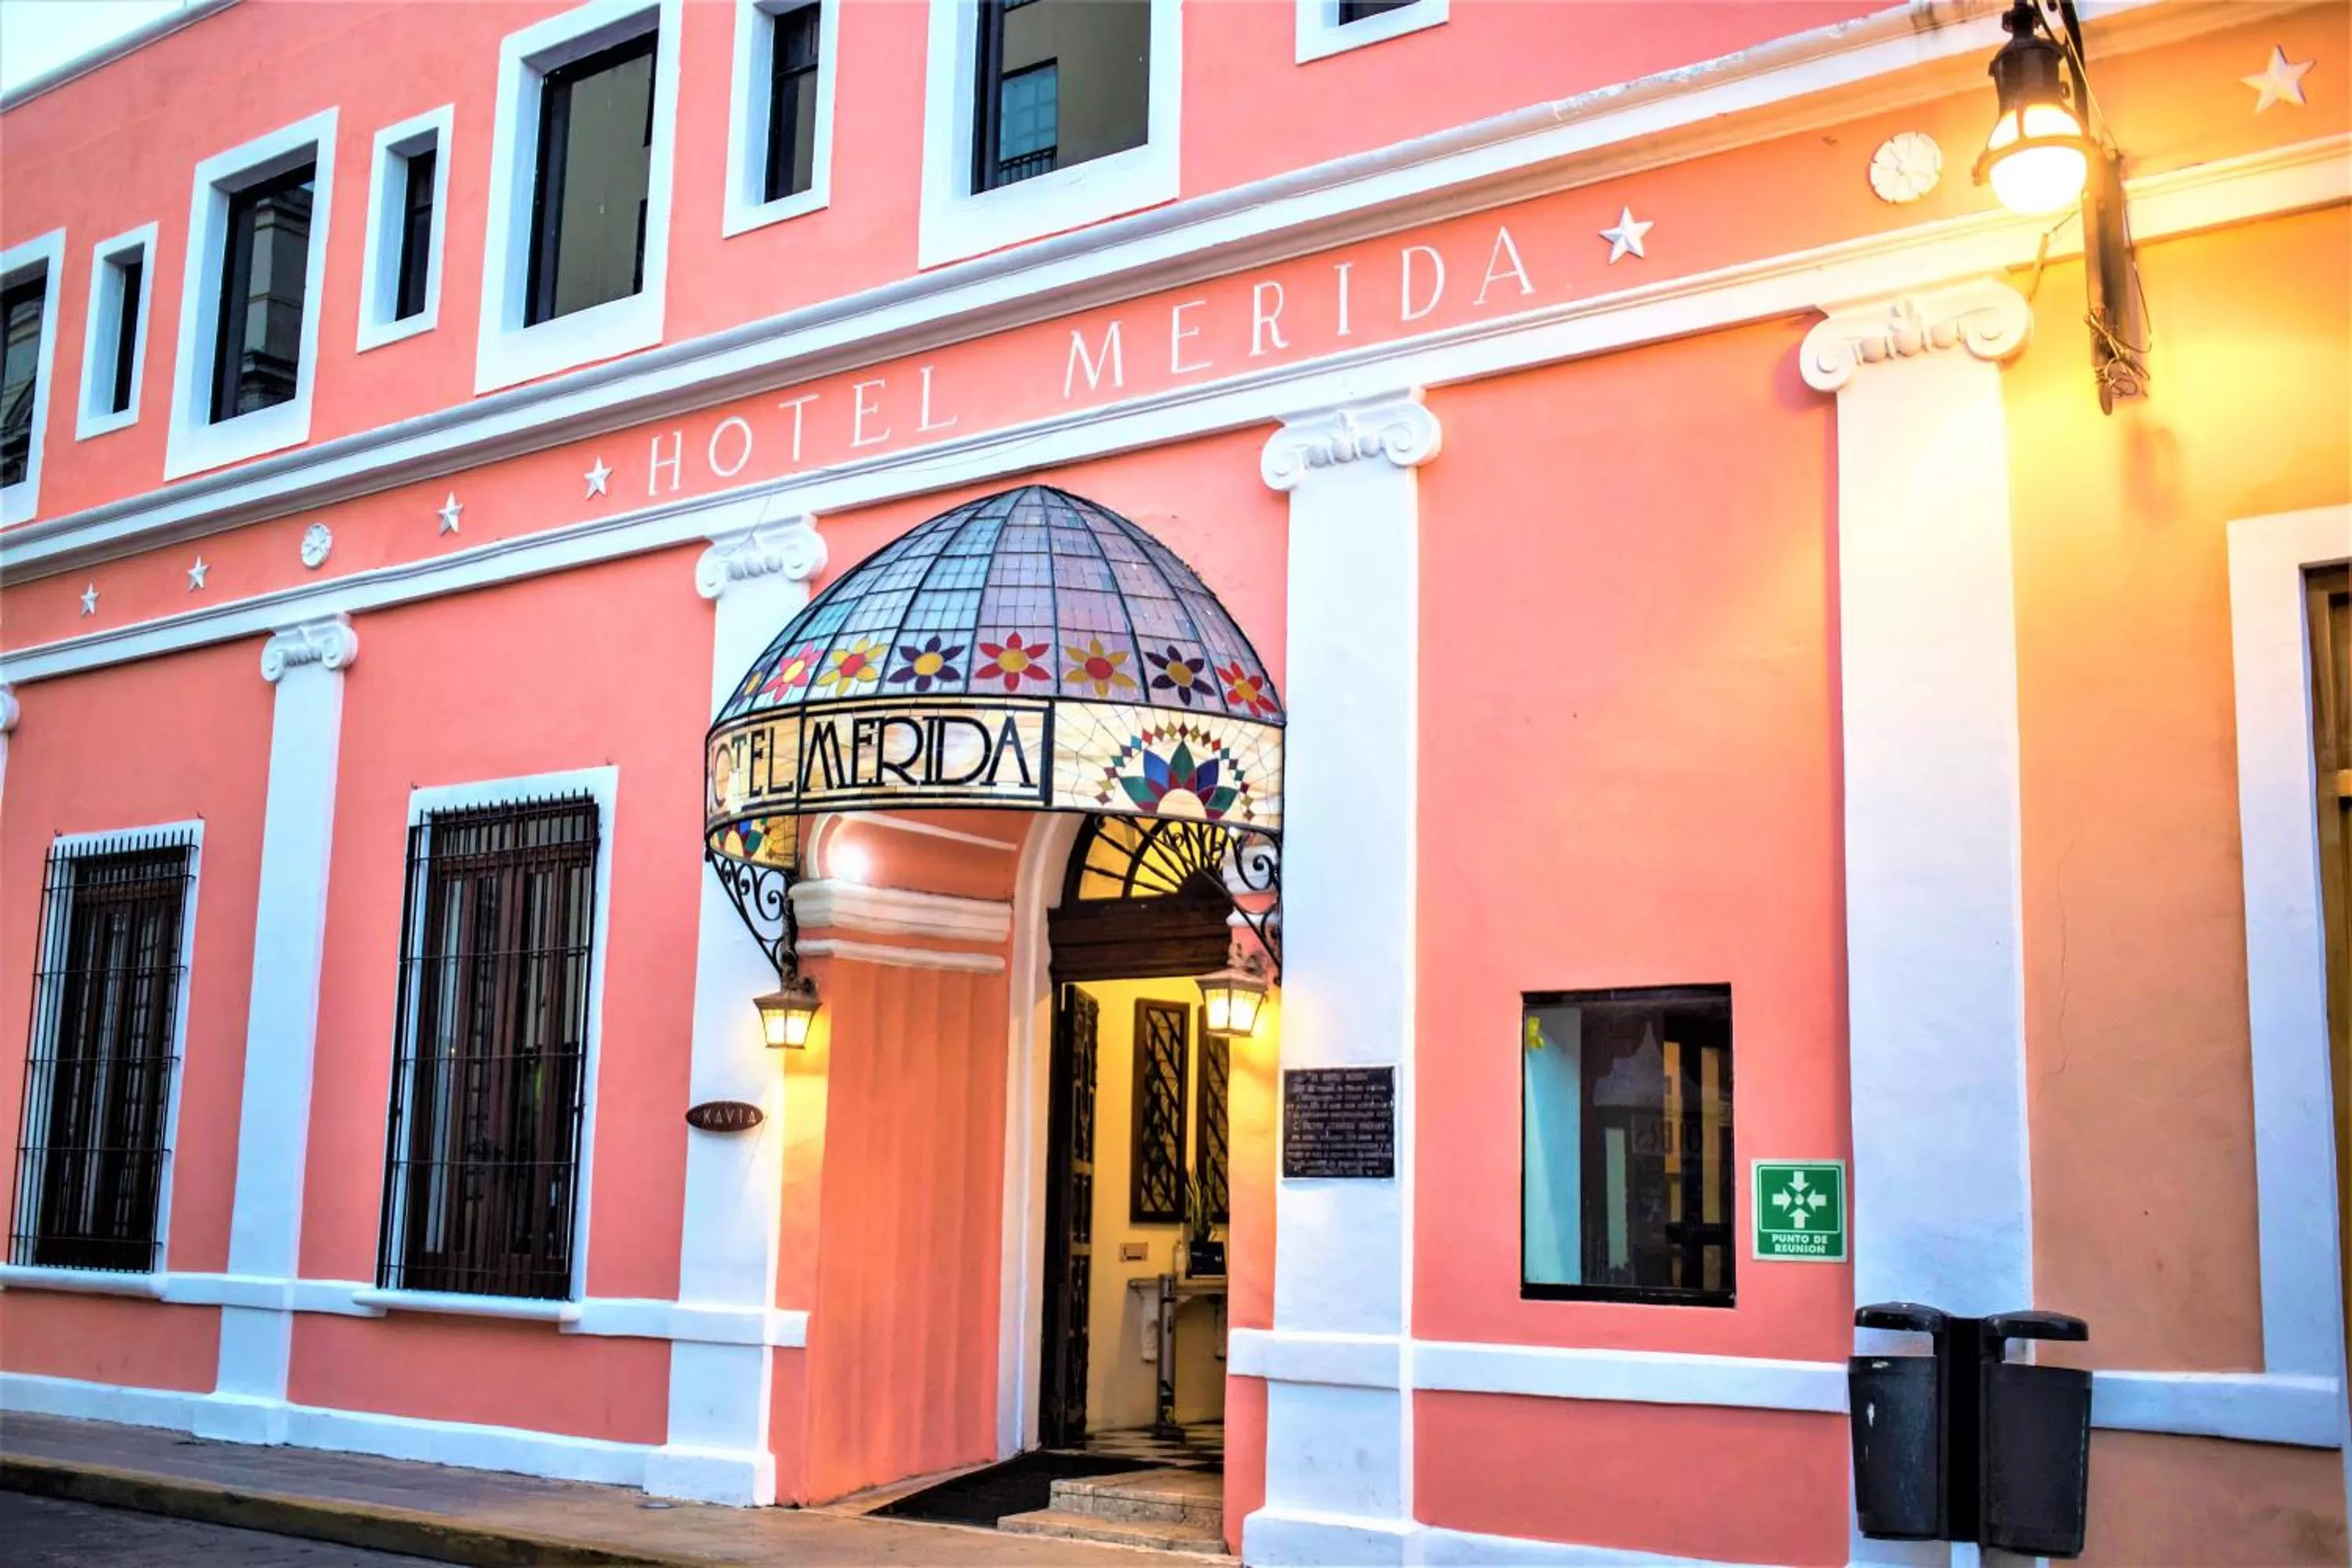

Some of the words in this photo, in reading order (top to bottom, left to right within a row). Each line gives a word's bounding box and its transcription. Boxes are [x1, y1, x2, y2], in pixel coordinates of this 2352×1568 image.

[648, 365, 958, 496] HOTEL
[1063, 225, 1537, 399] MERIDA
[801, 715, 1038, 792] MERIDA
[702, 1106, 757, 1123] KAVIA
[1771, 1233, 1809, 1243] PUNTO
[1813, 1235, 1828, 1244] DE
[1774, 1243, 1826, 1254] REUNION
